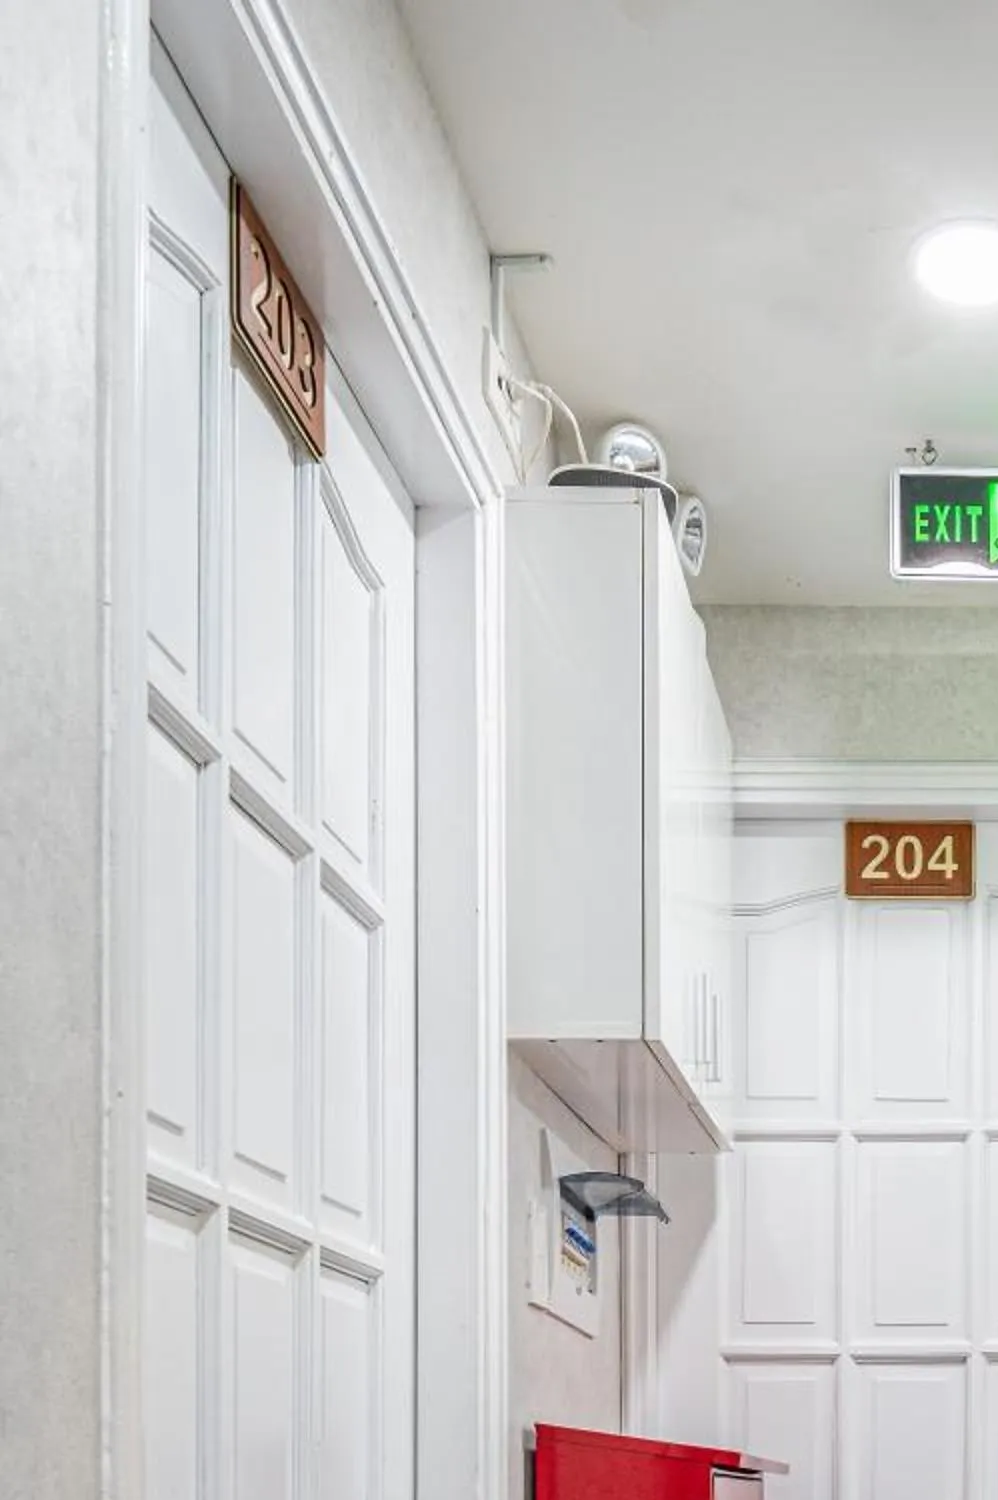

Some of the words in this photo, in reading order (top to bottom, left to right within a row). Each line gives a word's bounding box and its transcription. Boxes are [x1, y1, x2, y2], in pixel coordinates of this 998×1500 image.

[250, 232, 317, 409] 203
[914, 504, 983, 542] EXIT
[861, 834, 959, 880] 204
